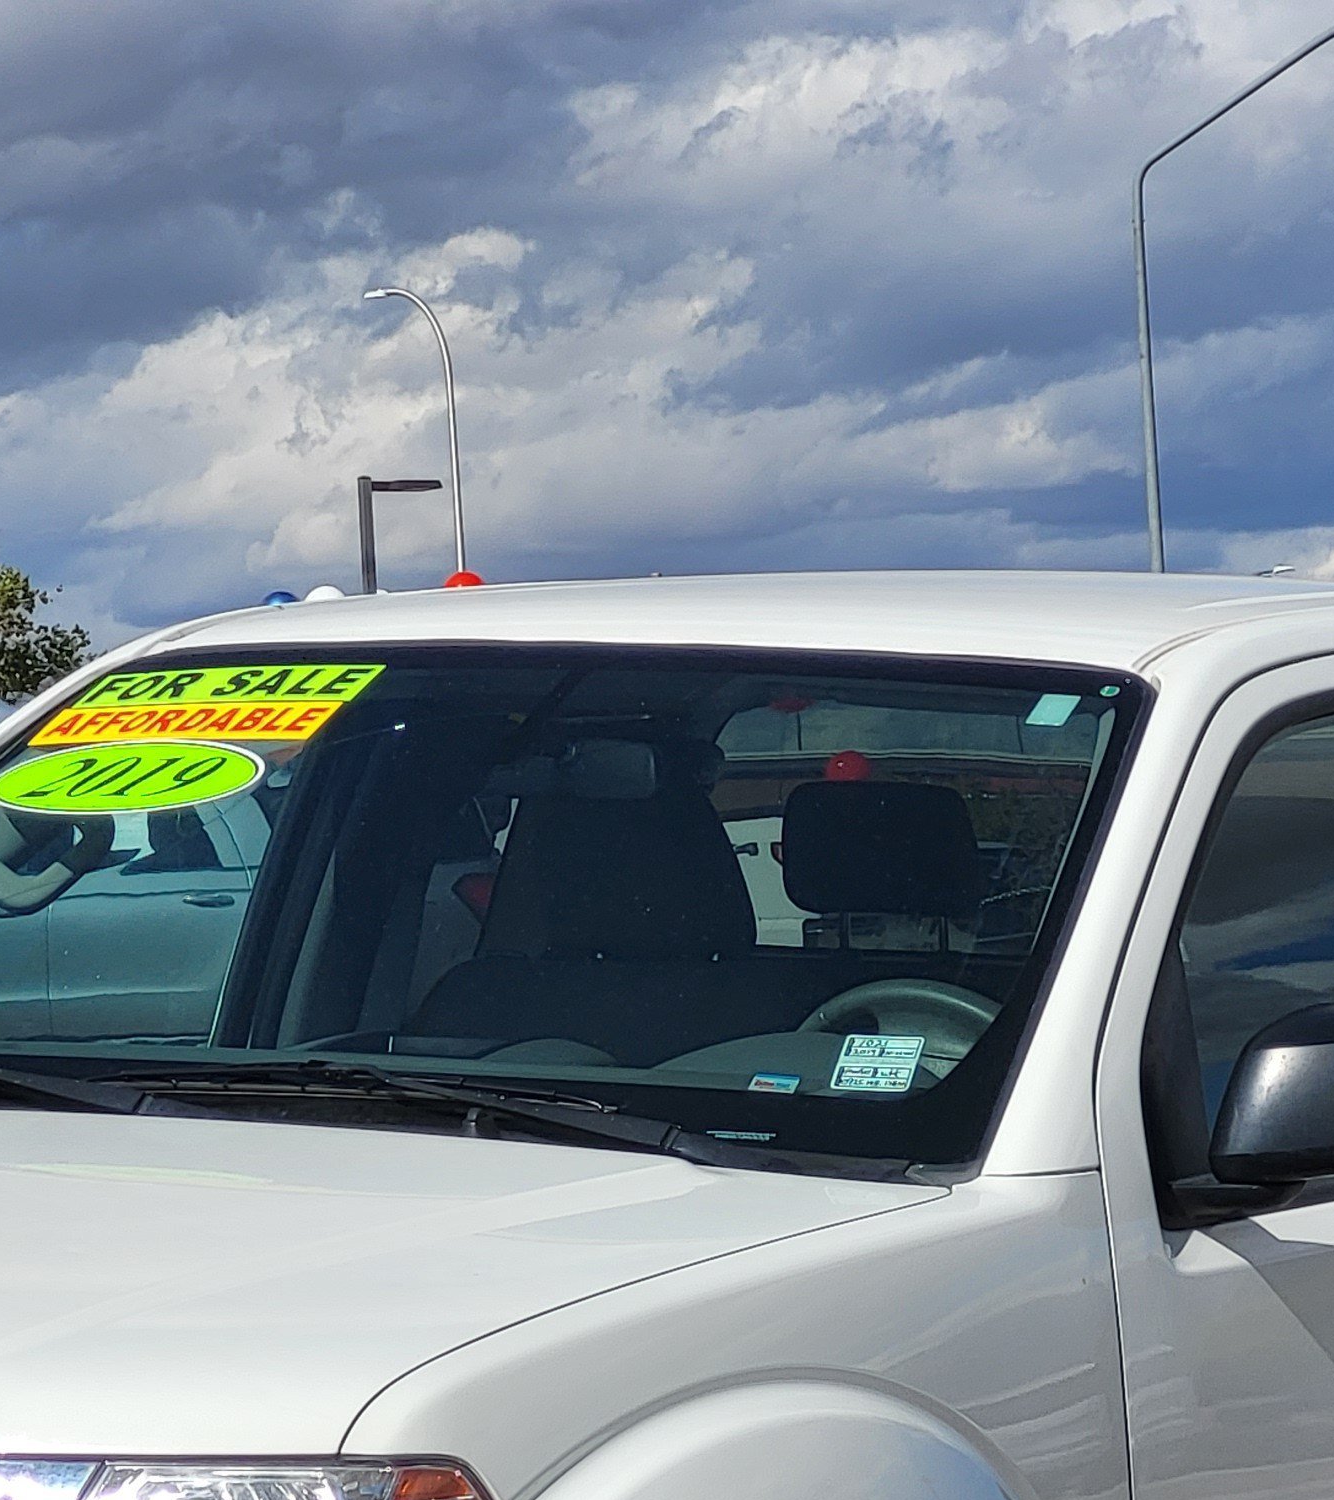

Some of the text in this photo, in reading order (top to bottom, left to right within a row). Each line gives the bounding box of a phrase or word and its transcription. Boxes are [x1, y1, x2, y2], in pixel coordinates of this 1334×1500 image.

[82, 667, 373, 704] FOR SALE
[43, 705, 330, 738] AFFORDABLE
[16, 756, 228, 799] 2019
